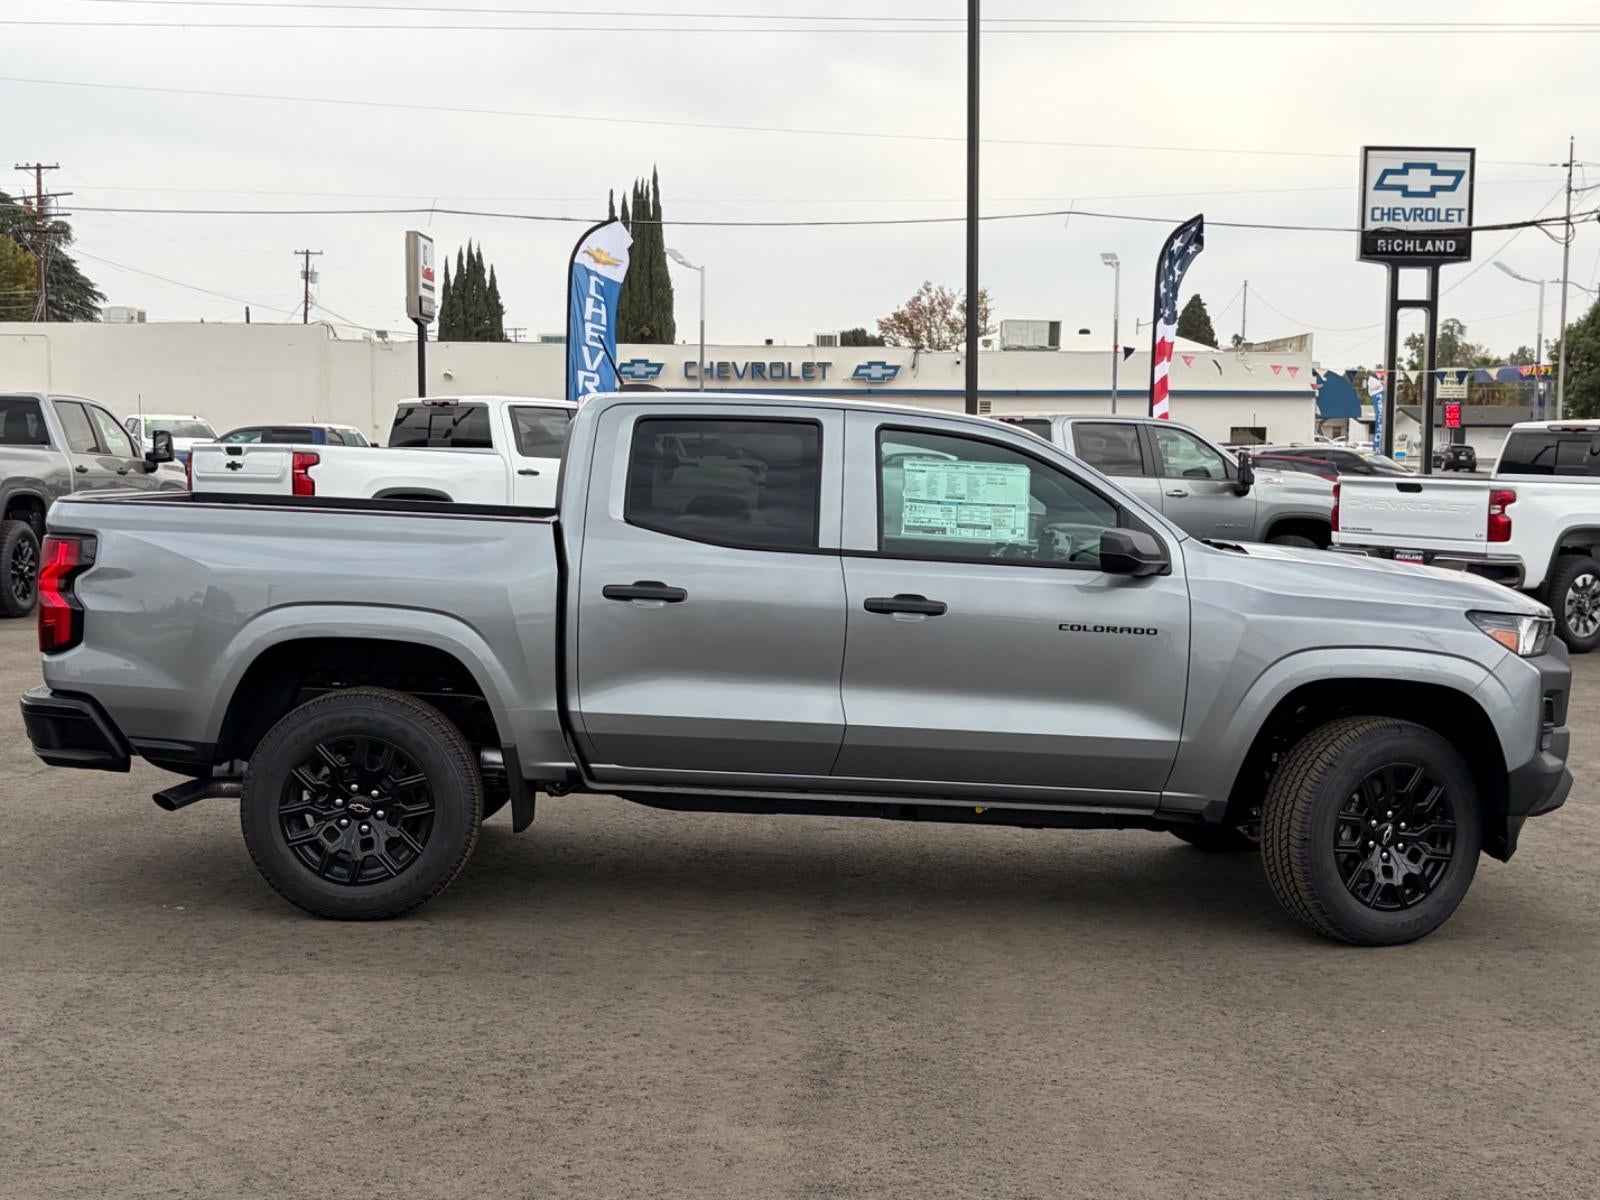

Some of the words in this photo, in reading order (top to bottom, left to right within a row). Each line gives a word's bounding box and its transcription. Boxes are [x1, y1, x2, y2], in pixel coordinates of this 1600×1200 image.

[1370, 206, 1466, 223] CHEVROLET
[1377, 239, 1456, 252] RICHLAND
[683, 361, 832, 381] CHEVROLET
[1346, 499, 1478, 515] CHEVROLET
[1058, 623, 1158, 636] COLORADO
